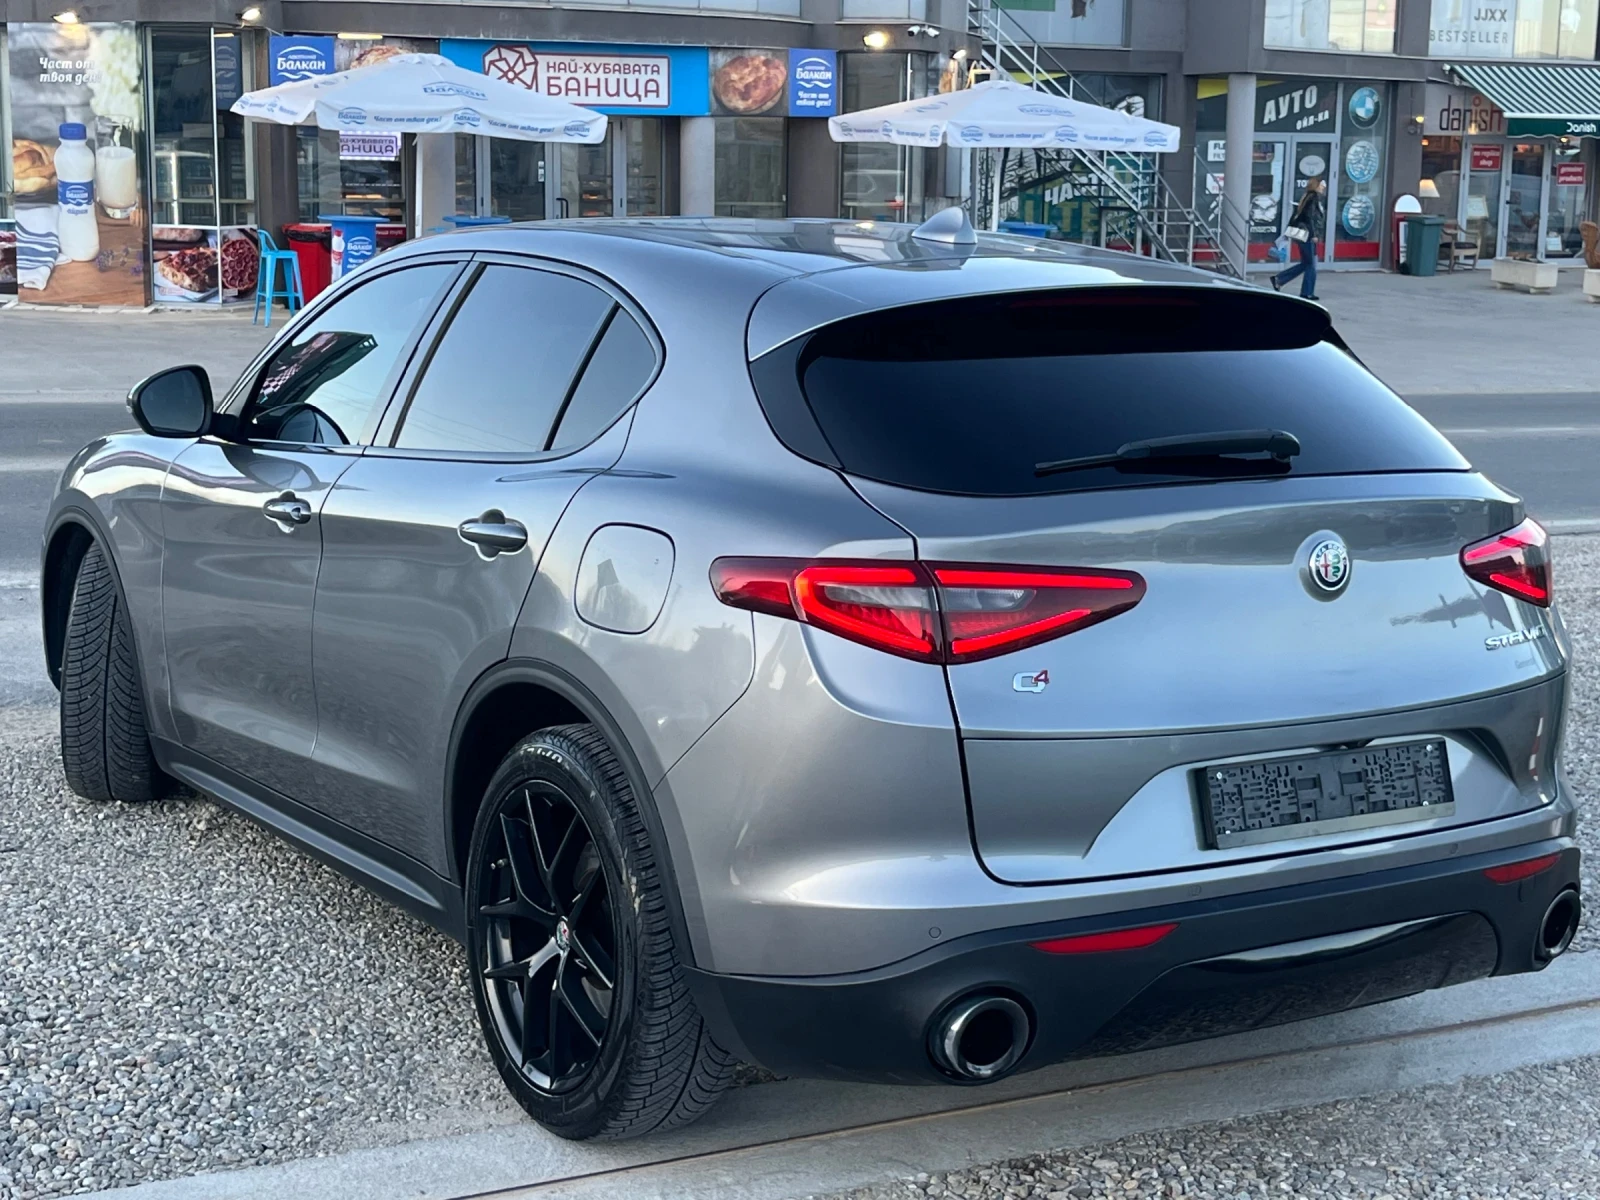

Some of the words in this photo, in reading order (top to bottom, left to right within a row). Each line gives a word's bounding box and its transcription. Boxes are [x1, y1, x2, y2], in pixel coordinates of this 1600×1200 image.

[1474, 8, 1507, 22] JJXX
[1429, 29, 1508, 44] BESTSELLER
[39, 57, 73, 69] Част
[277, 57, 326, 70] Балкан
[546, 58, 660, 75] НАЙ-ХУБАВАТА
[39, 71, 73, 83] твоя
[795, 67, 832, 80] Балкан
[546, 76, 660, 102] БАНИЦА
[1263, 85, 1318, 124] АУТО
[1440, 94, 1503, 131] danish
[1566, 122, 1597, 133] Danish
[341, 144, 394, 155] АНИЦА
[1012, 669, 1050, 694] Q4
